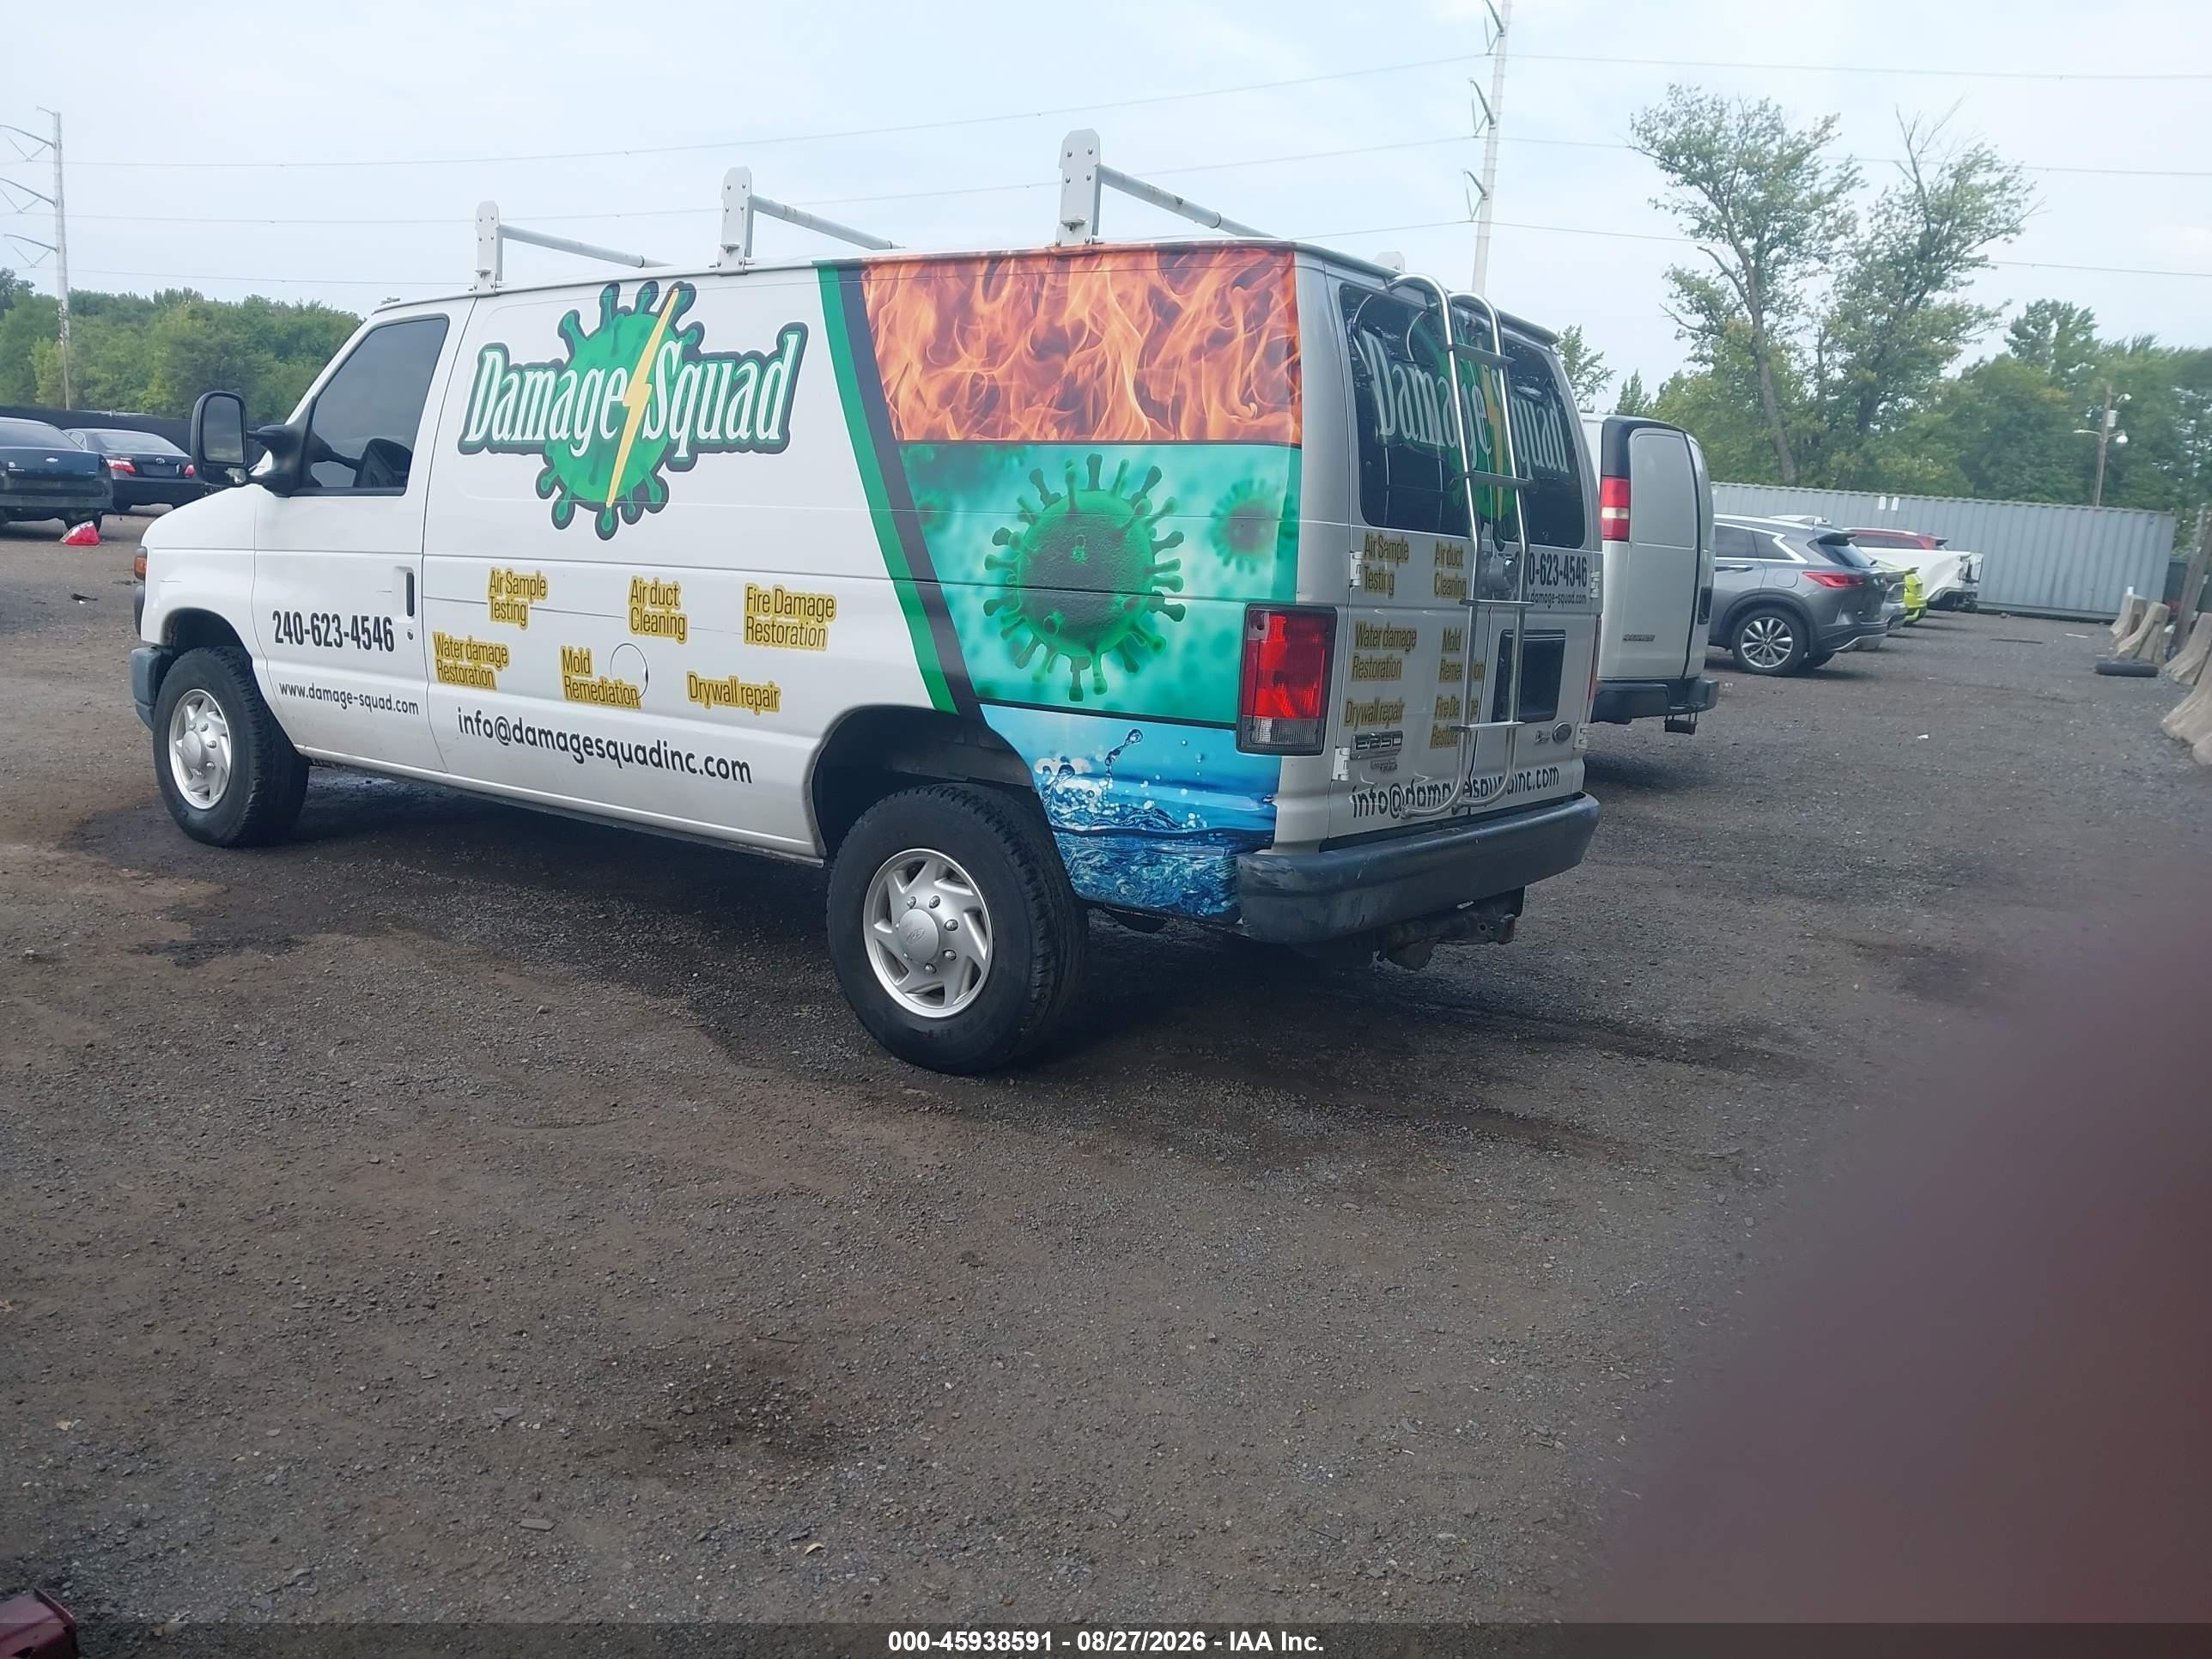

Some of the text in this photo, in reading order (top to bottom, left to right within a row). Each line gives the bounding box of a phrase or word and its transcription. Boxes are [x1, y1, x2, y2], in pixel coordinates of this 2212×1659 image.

[463, 333, 799, 459] Damage Squad
[1360, 329, 1492, 470] Damage
[1364, 533, 1409, 568] Air Sample
[1435, 541, 1463, 569] Air duct
[1364, 566, 1395, 596] Testing
[1515, 551, 1587, 586] 0-623-4546
[489, 569, 547, 601] Air Sample
[629, 578, 679, 607] Air duct
[1434, 572, 1467, 599] Cleaning
[489, 596, 527, 627] Testing
[745, 586, 835, 623] Fire Damage
[271, 610, 395, 653] 240-623-4546
[629, 606, 687, 641] Cleaning
[744, 614, 827, 648] Restoration
[1356, 623, 1416, 653] Water damage
[434, 634, 508, 668] Water damage
[1443, 628, 1461, 653] Mold
[436, 660, 495, 688] Restoration
[562, 648, 591, 675] Mold
[1352, 654, 1401, 679] Restoration
[279, 683, 419, 715] www.damage-squad.com
[564, 675, 640, 707] Remediation
[688, 672, 781, 714] Drywall repair
[1435, 694, 1448, 720] Fire
[1345, 697, 1405, 730] Drywall repair
[458, 707, 753, 784] info@damagesquadinc.com
